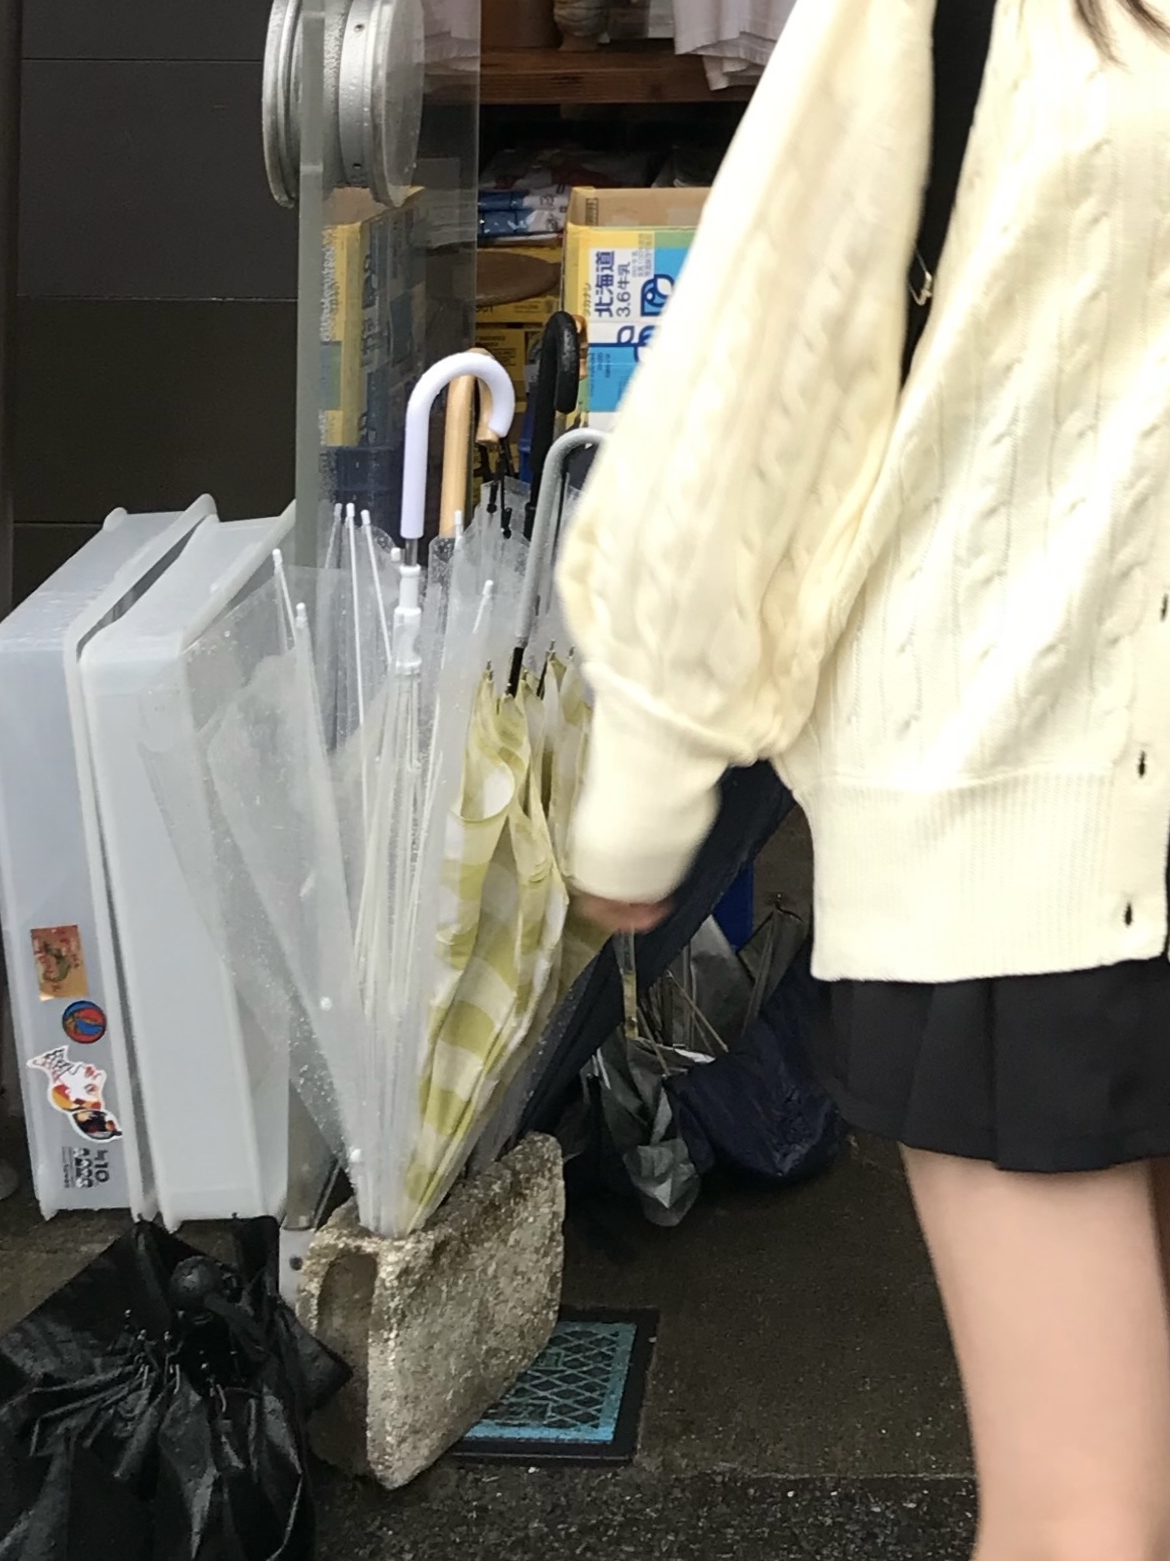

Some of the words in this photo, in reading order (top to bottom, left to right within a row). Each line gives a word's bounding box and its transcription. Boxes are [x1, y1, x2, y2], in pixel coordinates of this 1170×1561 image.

[594, 250, 615, 318] 北海道
[616, 262, 631, 318] 3.6牛乳
